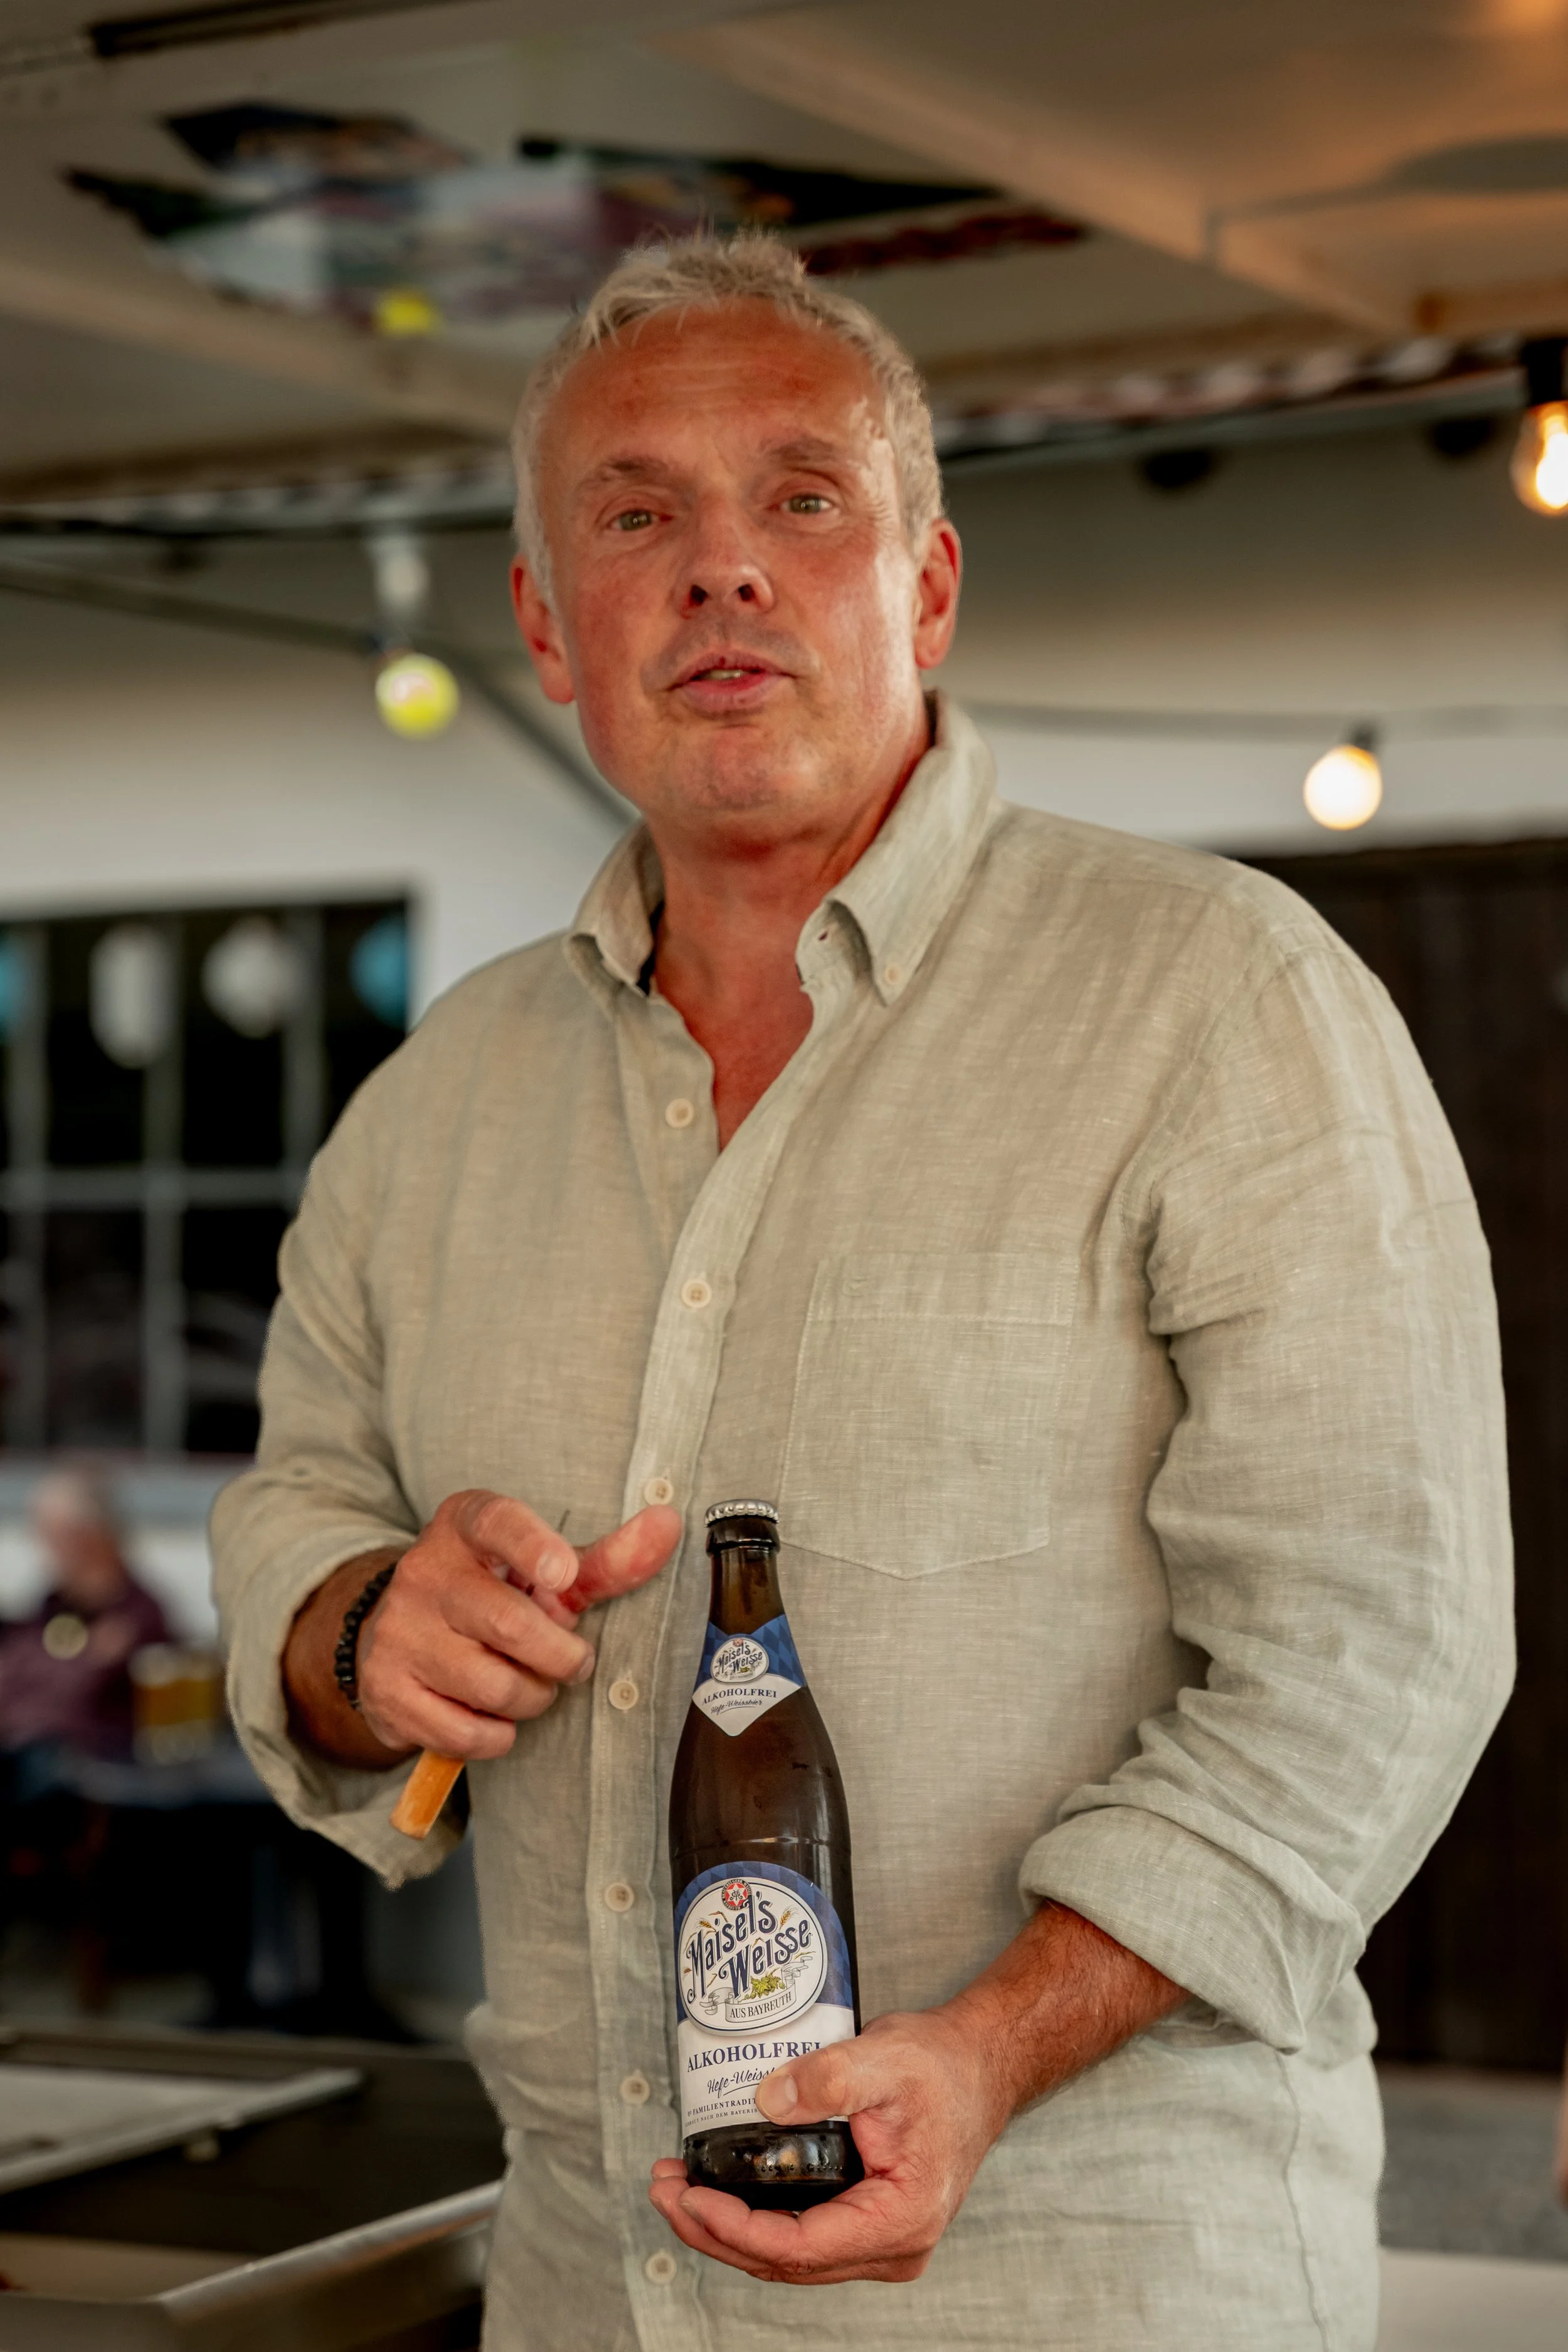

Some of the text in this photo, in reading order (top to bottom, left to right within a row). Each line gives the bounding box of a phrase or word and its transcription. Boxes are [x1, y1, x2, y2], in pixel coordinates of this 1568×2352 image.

[715, 1642, 751, 1677] Maisel's
[729, 1651, 763, 1673] Weisse
[702, 1688, 777, 1705] ALKOHOLFREI
[686, 1890, 778, 2005] Maisel's
[718, 1919, 813, 2001] Weisse
[730, 1991, 792, 2018] AUS BAYREUTH
[707, 2067, 775, 2099] Hefe-Weiss
[692, 2097, 756, 2116] FAMILIENTRADIT
